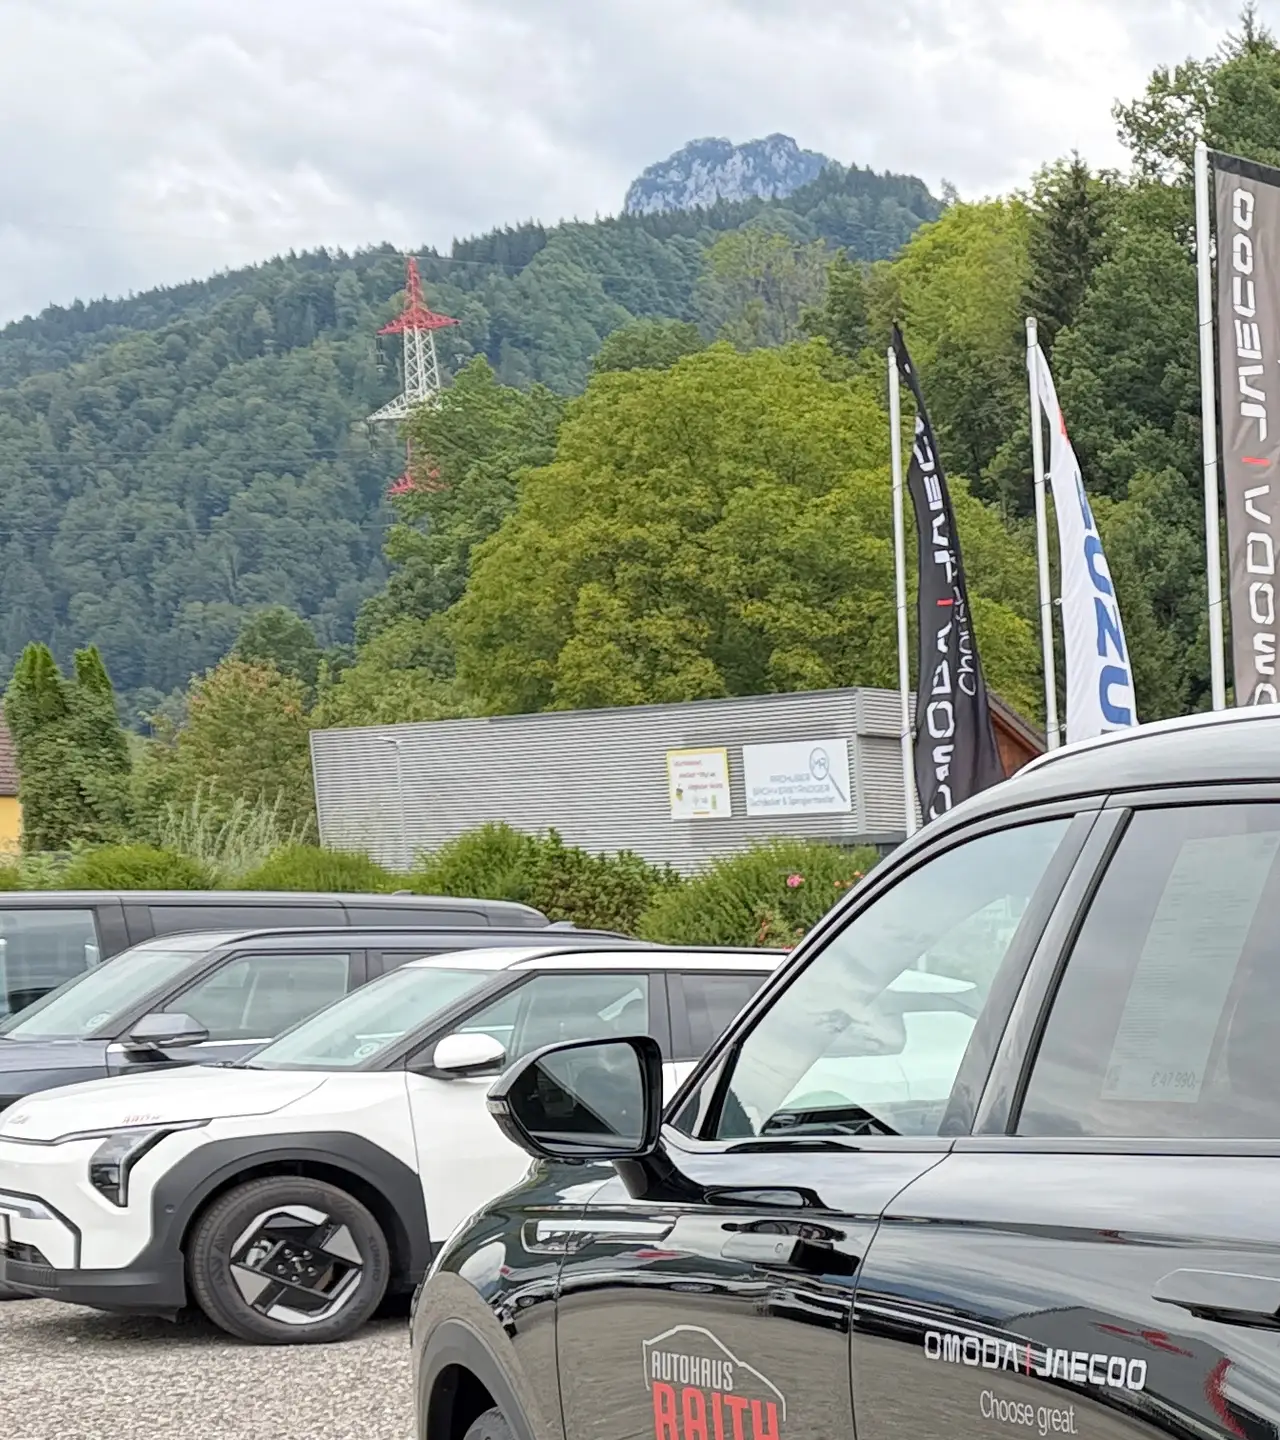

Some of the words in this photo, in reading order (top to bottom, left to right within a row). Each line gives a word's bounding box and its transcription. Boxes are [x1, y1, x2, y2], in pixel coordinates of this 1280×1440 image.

[1232, 187, 1268, 442] JAECOO
[651, 1350, 734, 1392] AUTOHAUS
[923, 1330, 1020, 1374] OMODA
[1034, 1346, 1149, 1392] JAECOO
[979, 1389, 1035, 1427] Choose
